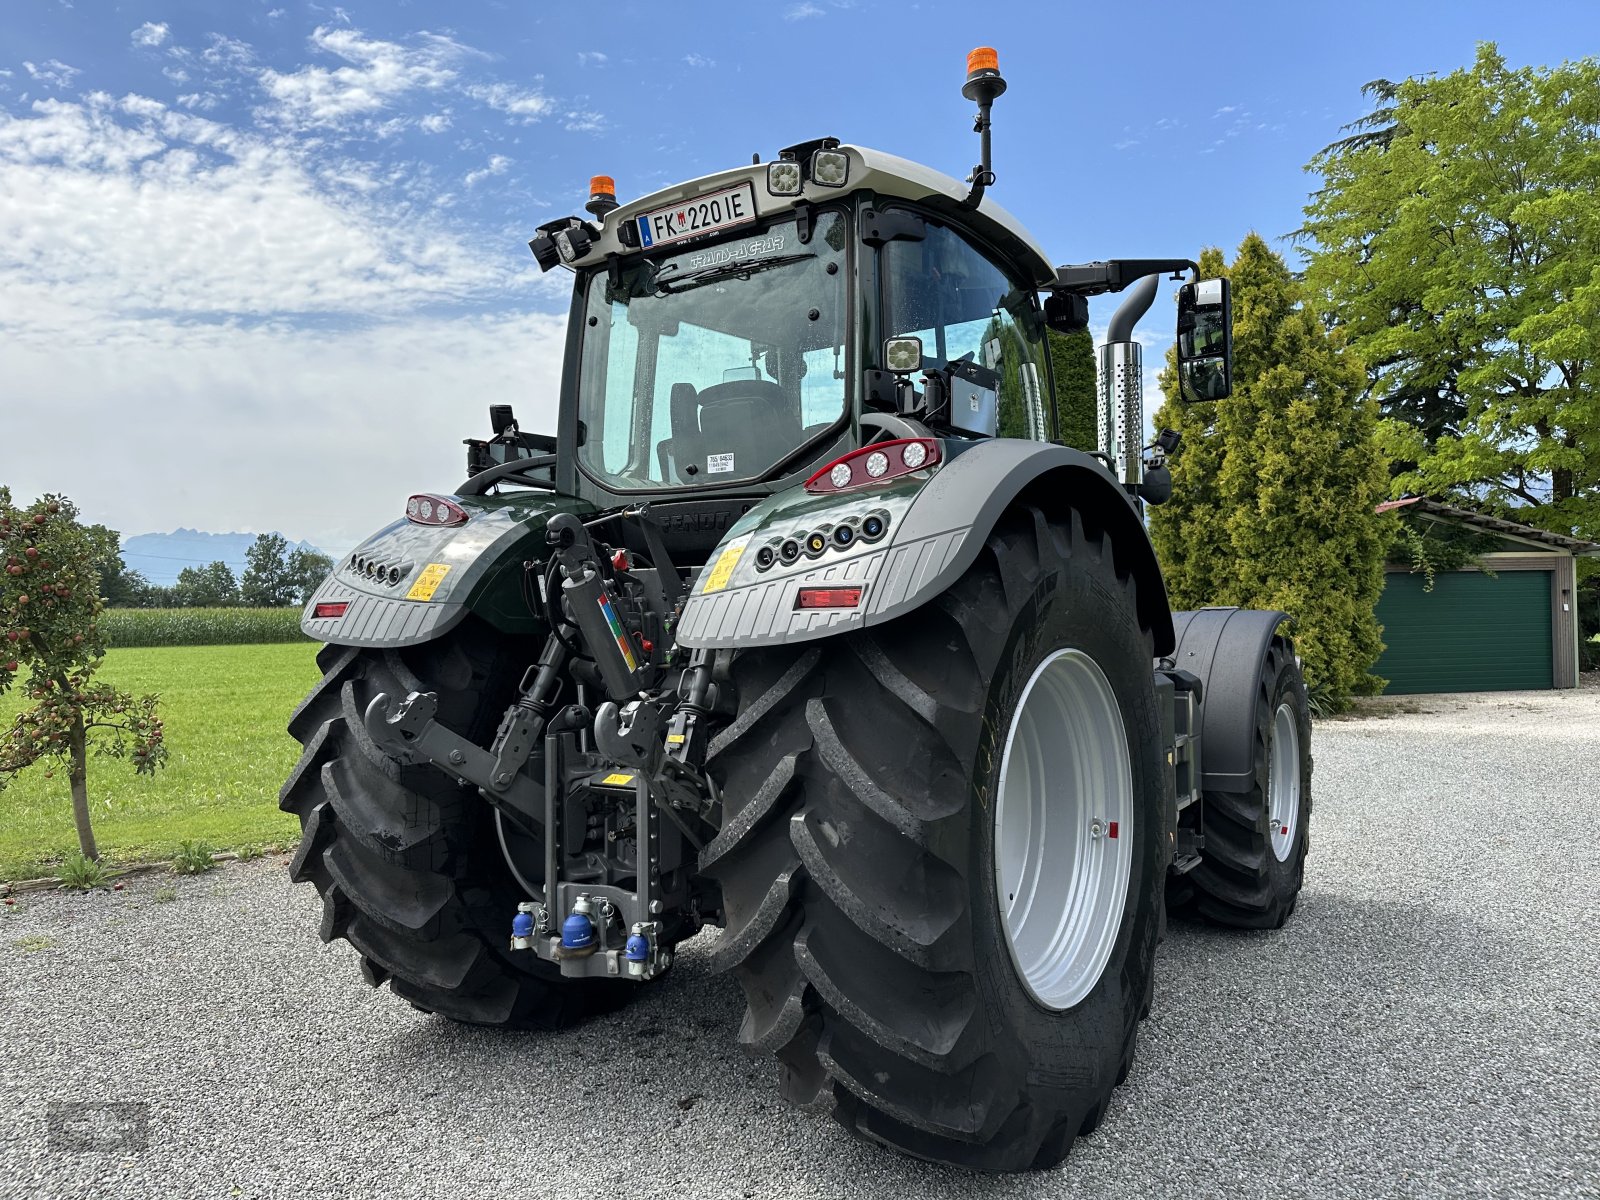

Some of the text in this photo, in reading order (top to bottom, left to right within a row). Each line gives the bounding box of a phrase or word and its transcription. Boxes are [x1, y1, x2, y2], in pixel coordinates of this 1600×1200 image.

[654, 212, 677, 239] FK
[688, 200, 722, 230] 220
[724, 193, 744, 220] IE
[690, 235, 785, 269] TRANS-AGRAR
[659, 511, 731, 533] FENDT
